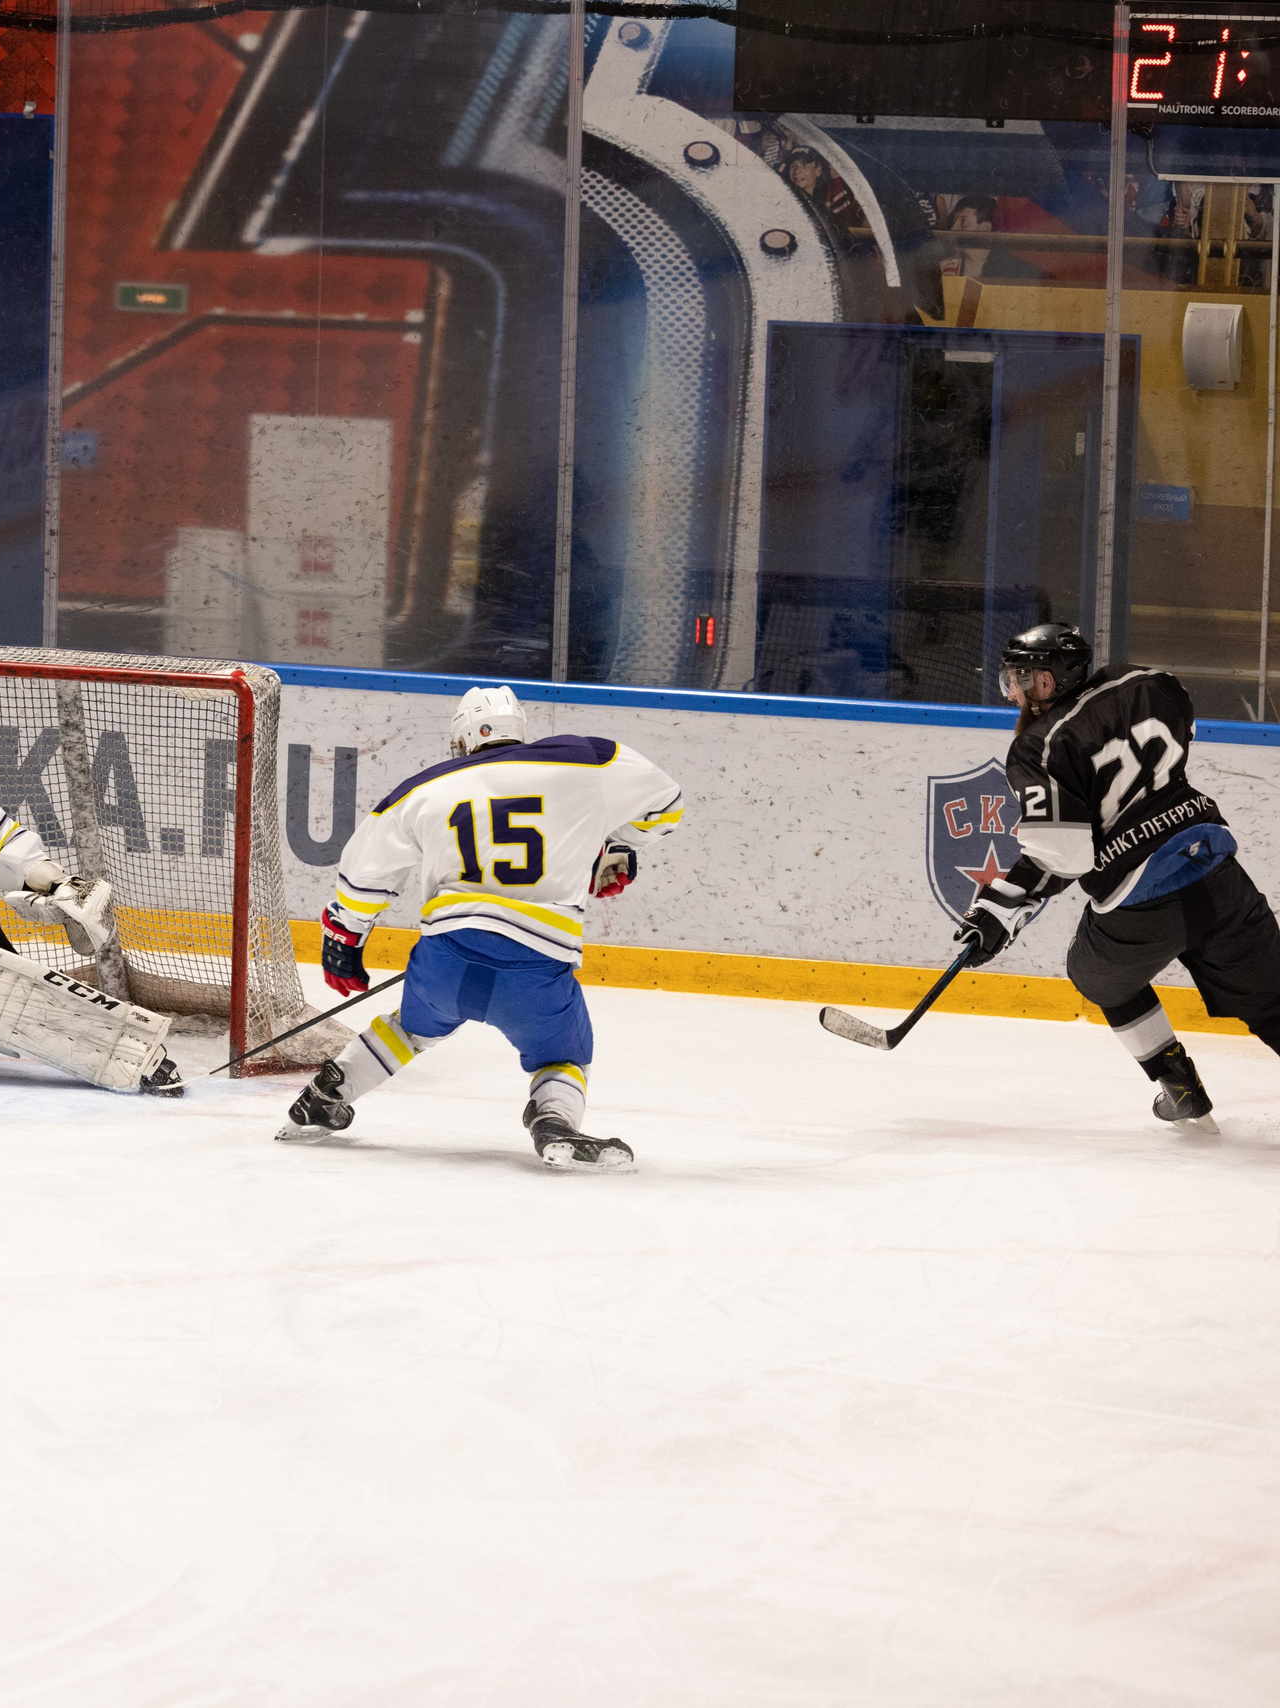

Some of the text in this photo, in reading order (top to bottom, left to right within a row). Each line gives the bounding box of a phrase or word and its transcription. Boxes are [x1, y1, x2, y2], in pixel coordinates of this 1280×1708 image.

[1158, 104, 1215, 115] NAUTRONIC
[1140, 491, 1188, 502] СЛУЖЕБНЫЙ
[1153, 503, 1174, 512] ВХОД
[1091, 716, 1184, 835] 22
[447, 795, 546, 887] 15
[43, 970, 121, 1011] CCM
